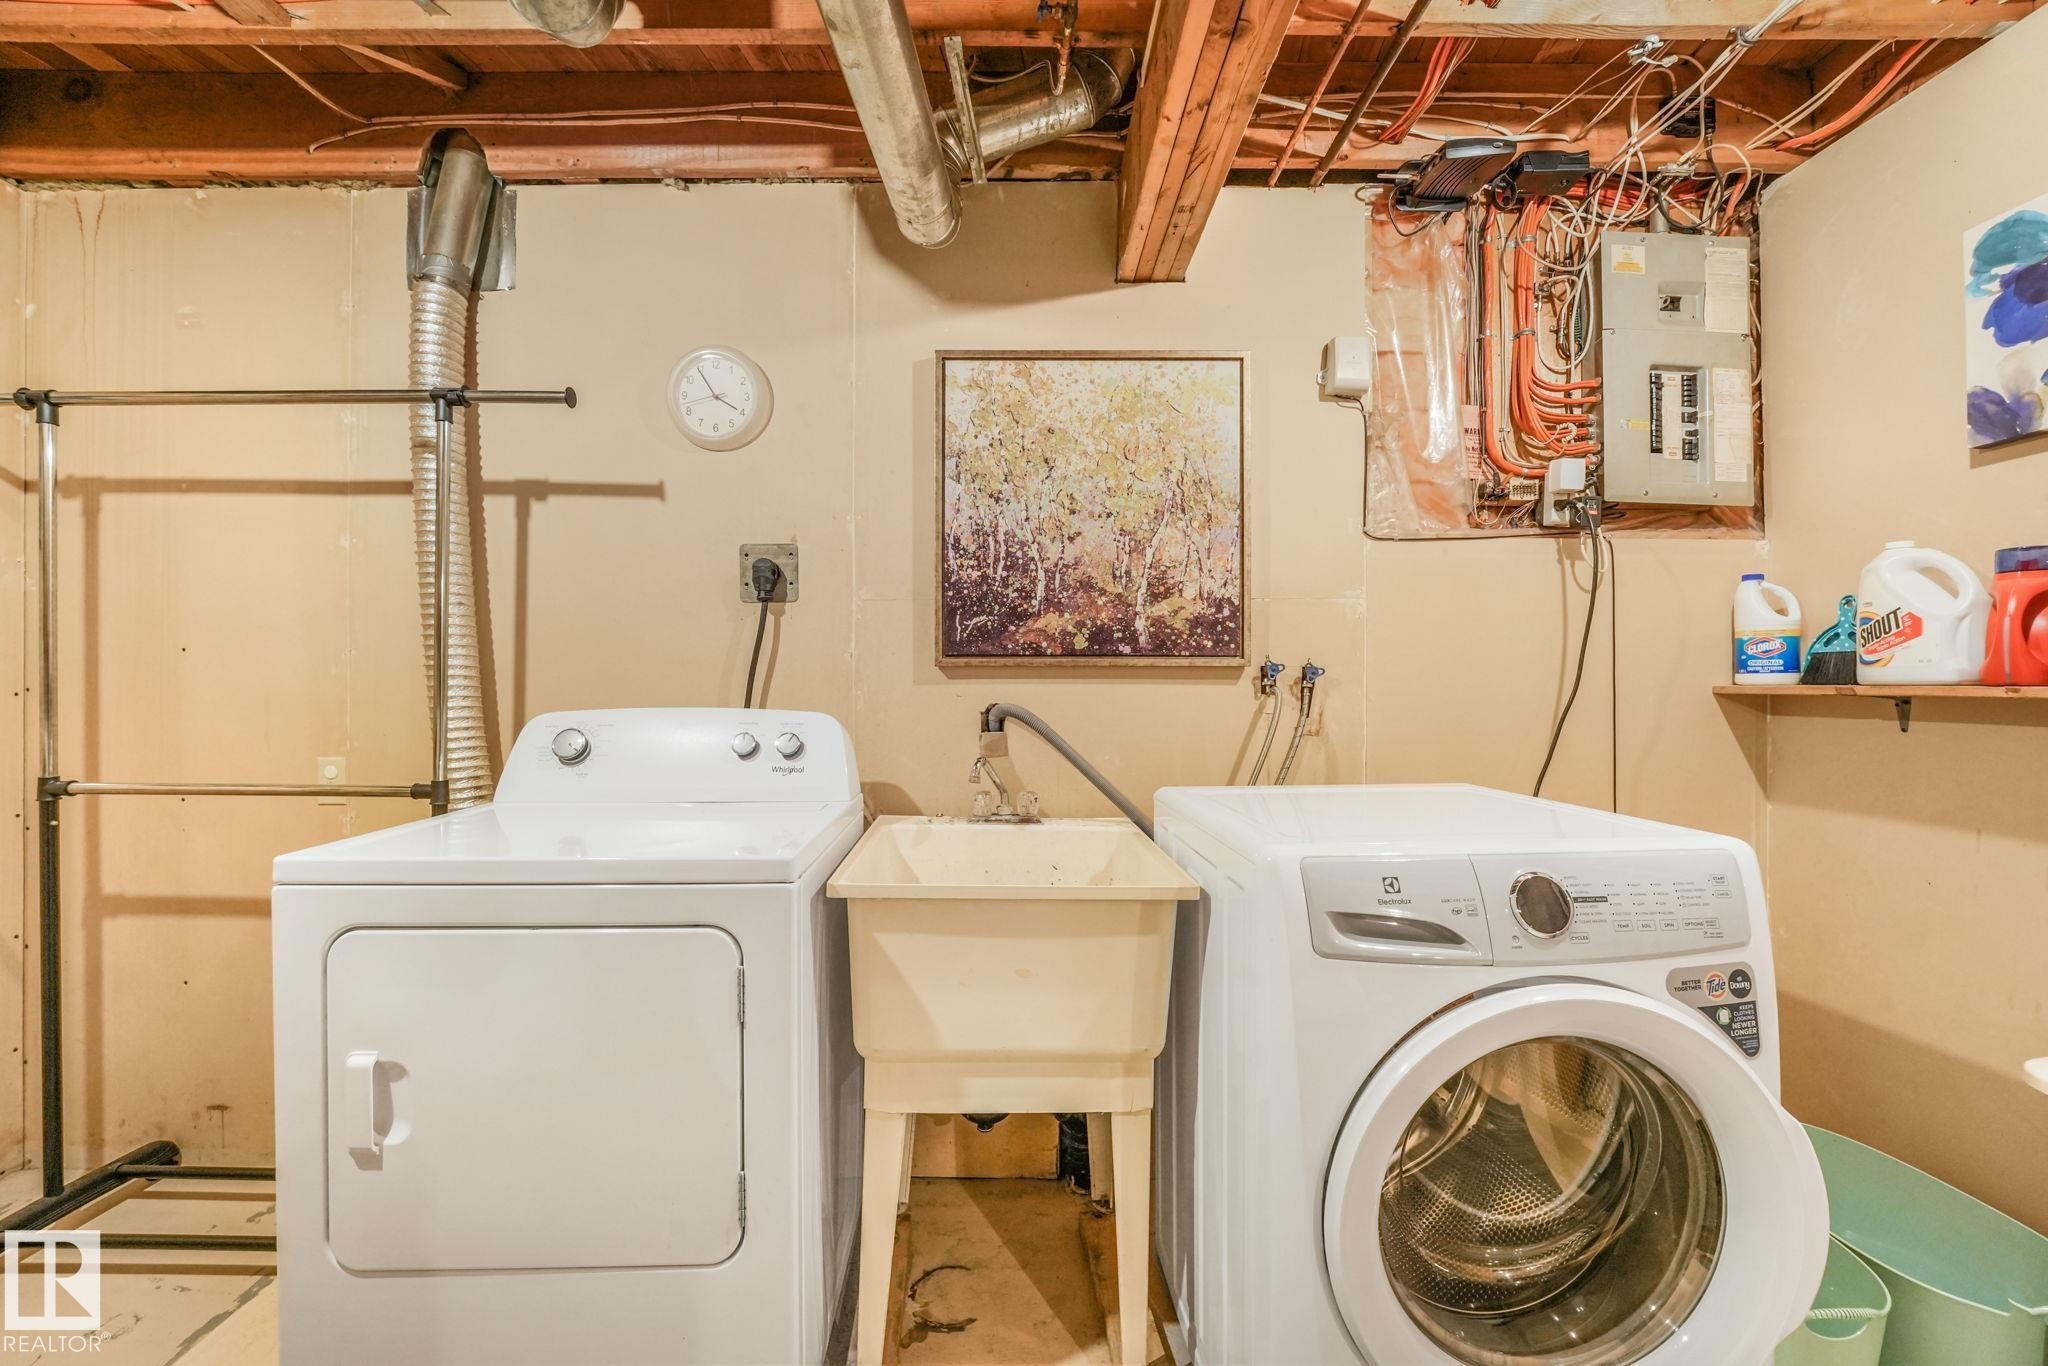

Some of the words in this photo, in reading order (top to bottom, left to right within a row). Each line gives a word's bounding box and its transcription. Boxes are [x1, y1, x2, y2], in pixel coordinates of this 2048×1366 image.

[711, 360, 720, 369] 12
[686, 376, 694, 384] 10
[740, 376, 746, 386] 2
[682, 391, 688, 400] 9
[744, 392, 750, 401] 3
[686, 407, 692, 416] 8
[739, 408, 745, 417] 4
[698, 418, 704, 427] 7
[728, 419, 735, 428] 5
[712, 423, 719, 432] 6
[1860, 606, 1901, 648] SHOUT
[1748, 640, 1781, 654] CLOROX
[771, 764, 805, 776] Whirlpool
[1377, 898, 1412, 906] Electrolux
[1673, 984, 1702, 992] TOGETHER
[1706, 978, 1726, 996] Tide
[1729, 981, 1751, 990] Downy
[1732, 1021, 1756, 1029] NEWER
[1731, 1028, 1757, 1036] LONGER
